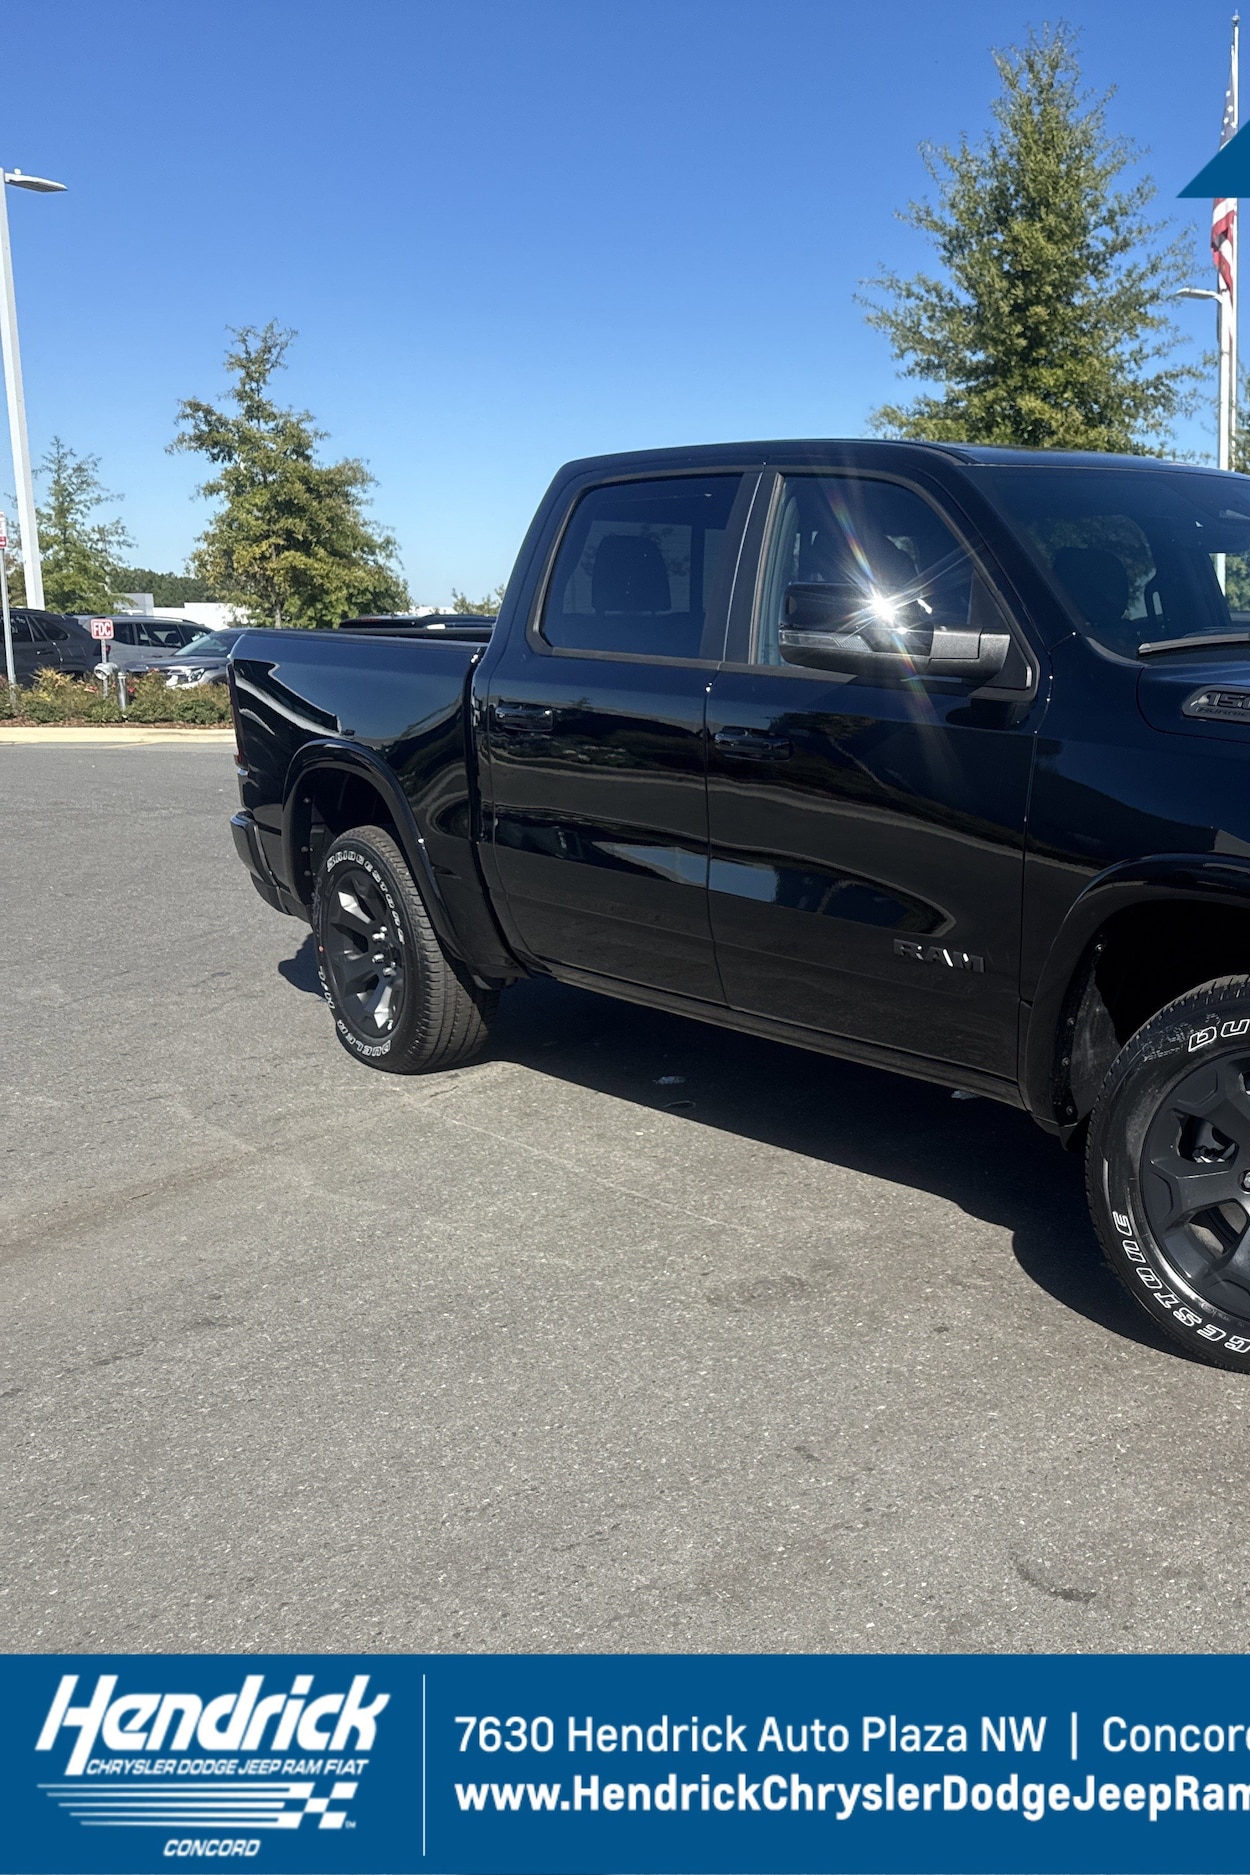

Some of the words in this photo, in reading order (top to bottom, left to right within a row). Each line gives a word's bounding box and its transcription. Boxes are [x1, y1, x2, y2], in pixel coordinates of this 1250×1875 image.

[93, 622, 111, 636] FDC
[326, 849, 406, 946] BRIDGESTONE
[893, 938, 985, 974] RAM
[337, 1019, 391, 1057] DUELER
